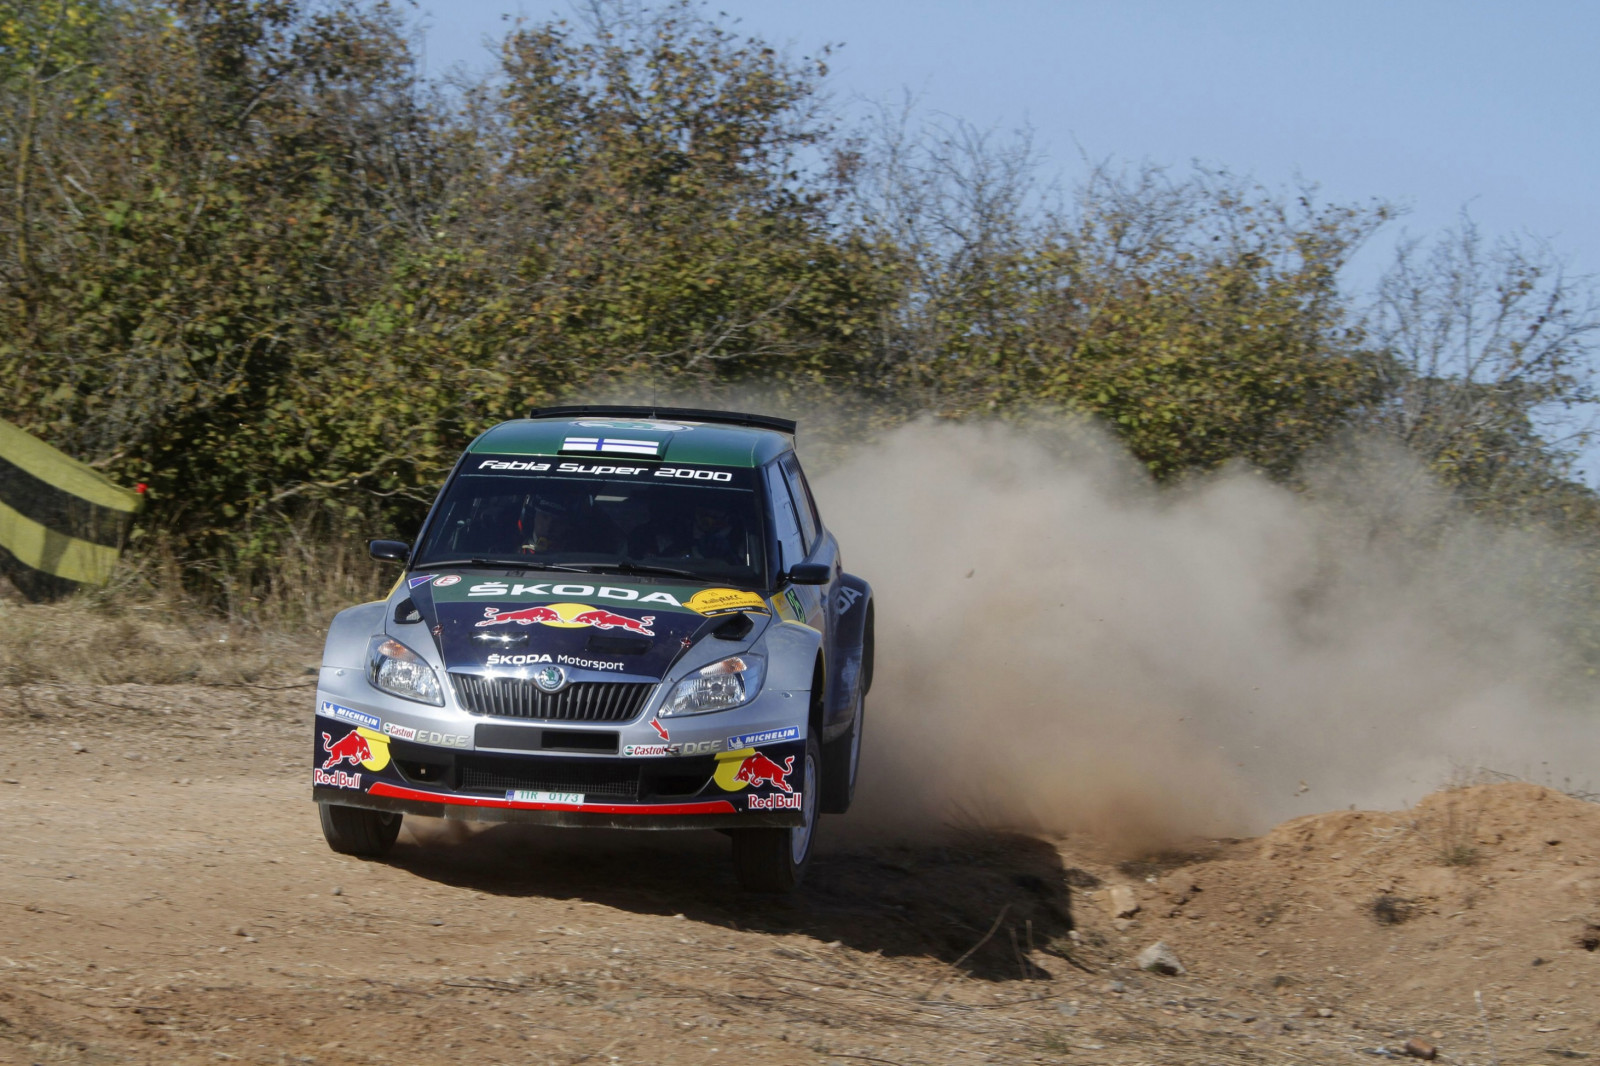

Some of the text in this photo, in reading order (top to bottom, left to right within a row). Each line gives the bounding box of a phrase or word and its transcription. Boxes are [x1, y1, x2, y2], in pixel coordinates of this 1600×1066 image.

[478, 460, 733, 482] Fabia Super 2000
[467, 581, 683, 607] ŠKODA
[486, 653, 625, 671] ŠKODA Motorsport
[336, 708, 378, 726] MICHELIN
[390, 725, 470, 748] Castrol EDGE
[745, 728, 796, 743] MICHELIN
[634, 745, 666, 756] Castrol
[314, 768, 362, 789] Red Bull
[748, 792, 802, 810] Red Bull
